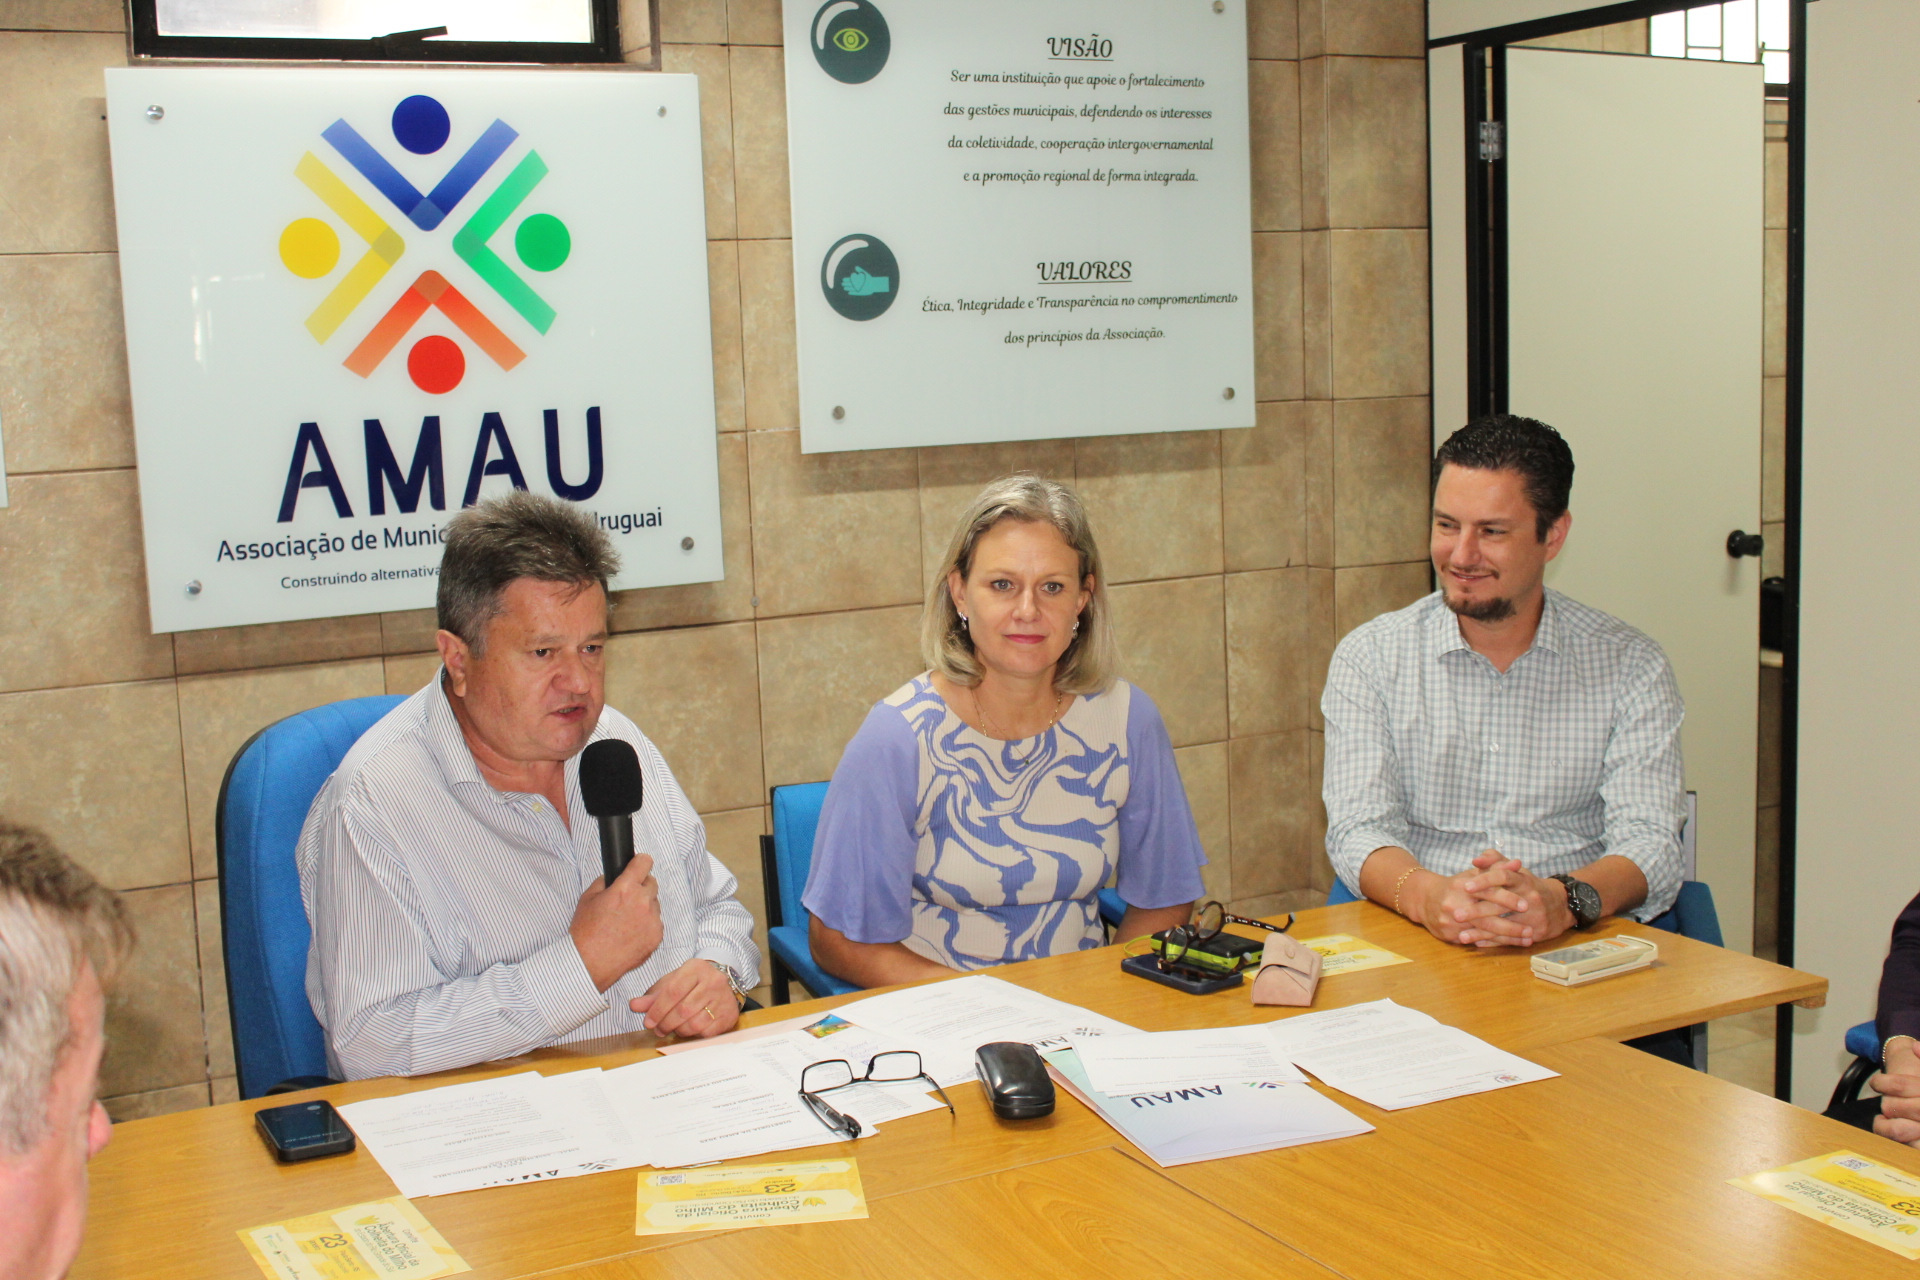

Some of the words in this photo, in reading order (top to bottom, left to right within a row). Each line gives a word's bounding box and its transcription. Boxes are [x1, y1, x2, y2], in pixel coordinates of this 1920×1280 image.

[1047, 33, 1113, 58] VISÃO
[951, 70, 971, 82] Ser
[974, 74, 999, 83] uma
[1002, 72, 1061, 87] instituição
[1064, 76, 1084, 89] que
[1086, 74, 1117, 90] apoie
[1119, 77, 1126, 86] o
[1127, 73, 1205, 91] fortalecimento
[944, 102, 964, 115] das
[968, 104, 1010, 120] gestões
[1013, 105, 1078, 121] municipais,
[1080, 104, 1143, 122] defendendo
[1146, 110, 1157, 118] os
[1160, 107, 1212, 119] interesses
[948, 135, 963, 148] da
[966, 135, 1038, 150] coletividade,
[1040, 138, 1105, 154] cooperação
[1108, 138, 1213, 154] intergovernamental
[964, 172, 970, 181] e
[972, 172, 980, 181] a
[982, 169, 1041, 186] promoção
[1044, 168, 1091, 186] regional
[1093, 168, 1106, 181] de
[1107, 168, 1141, 186] forma
[1144, 168, 1198, 186] integrada.
[1037, 261, 1132, 281] VALORES
[922, 296, 954, 312] Ética,
[957, 296, 1025, 315] Integridade
[1028, 300, 1034, 308] e
[1037, 295, 1118, 312] Transparência
[1121, 298, 1135, 306] no
[1138, 293, 1238, 309] compromentimento
[1004, 331, 1024, 344] dos
[1027, 330, 1083, 348] princípios
[1086, 328, 1100, 341] da
[1103, 327, 1165, 341] Associação.
[276, 406, 605, 523] AMAU
[216, 532, 345, 562] Associação
[351, 530, 377, 550] de
[280, 570, 367, 589] Construindo
[1130, 1085, 1223, 1108] AMAU
[764, 1183, 796, 1193] 23
[320, 1234, 347, 1248] 23
